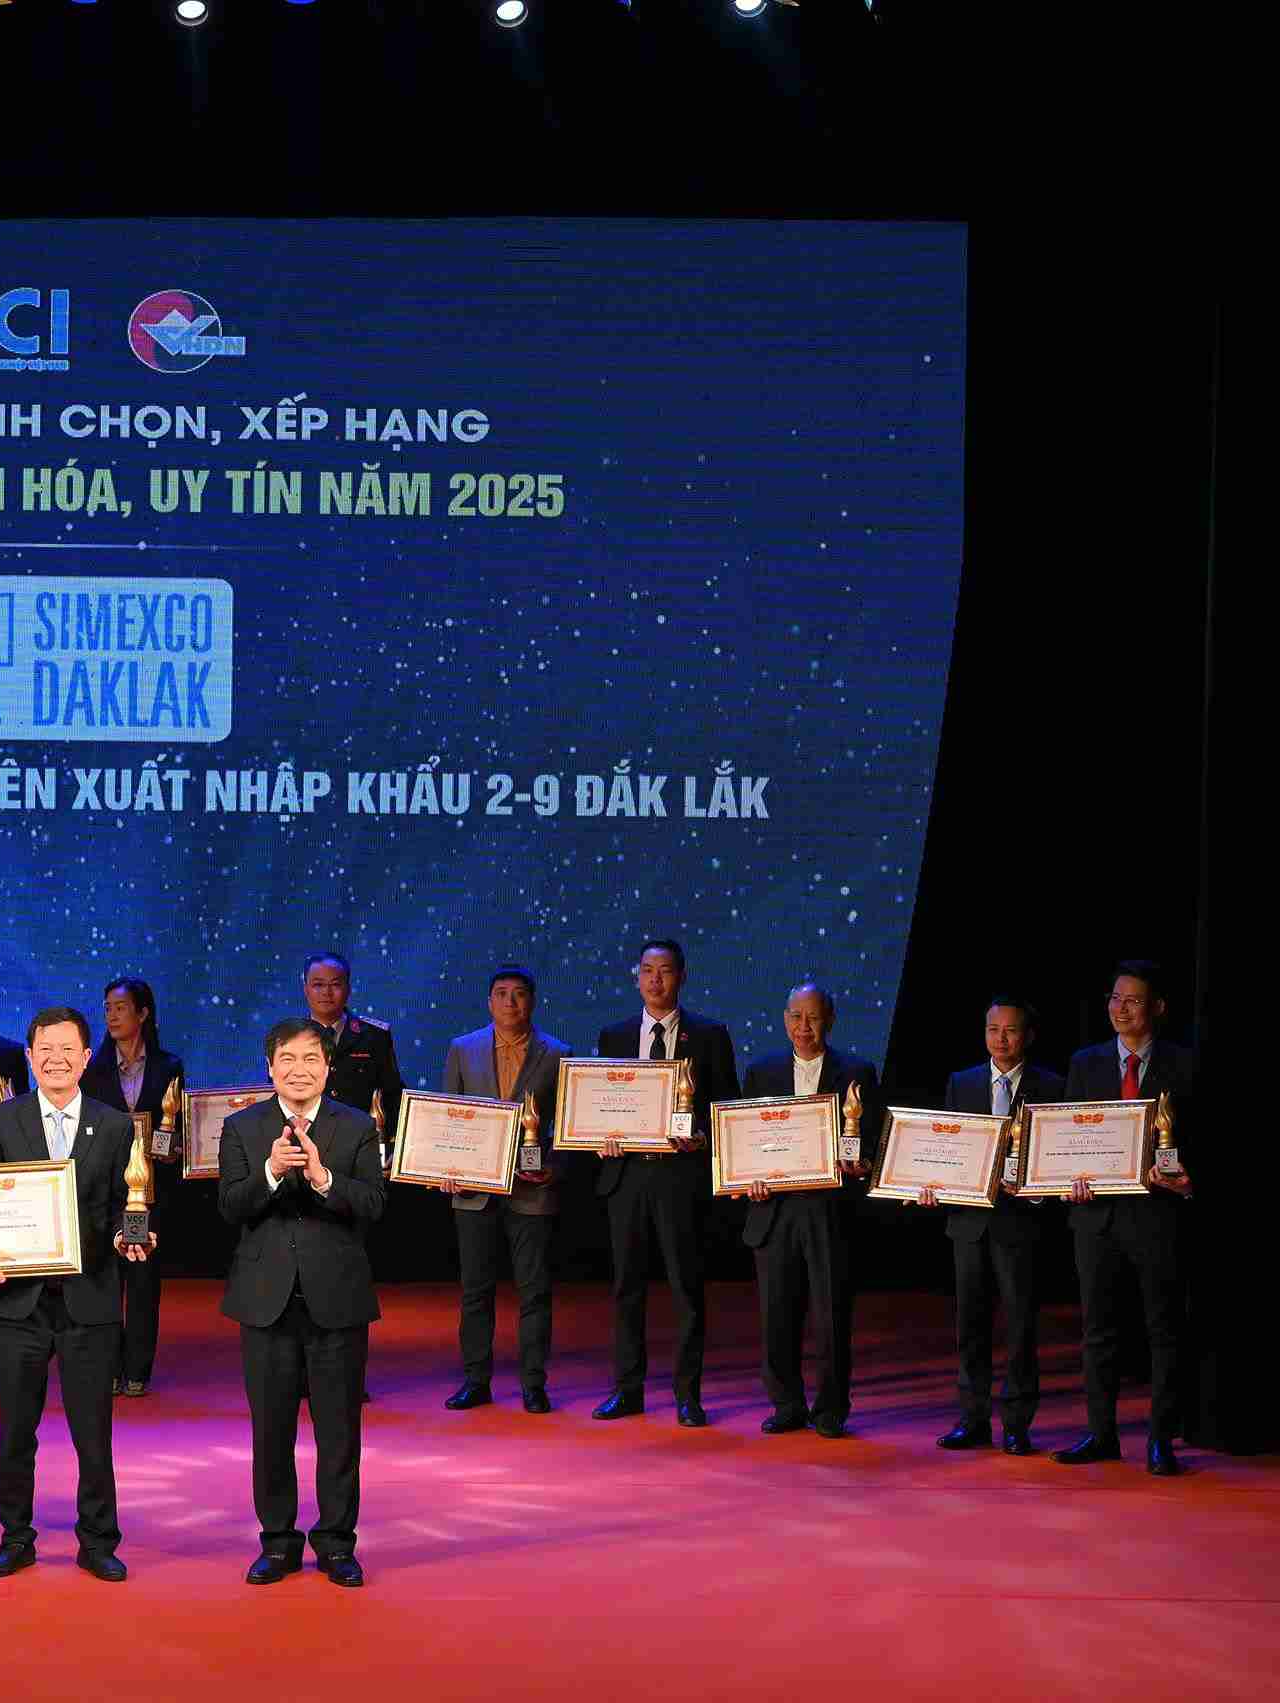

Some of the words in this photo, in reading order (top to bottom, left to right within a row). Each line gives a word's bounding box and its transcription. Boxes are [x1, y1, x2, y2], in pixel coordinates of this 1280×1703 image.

[60, 405, 220, 448] CHỌN,
[240, 393, 328, 440] XẾP
[346, 408, 489, 451] HẠNG
[23, 459, 131, 516] HÓA,
[151, 470, 209, 512] UY
[226, 461, 301, 513] TÍN
[320, 463, 430, 515] NĂM
[448, 474, 563, 516] 2025
[33, 591, 213, 653] SIMEXCO
[32, 659, 212, 728] DAKLAK
[72, 754, 190, 810] XUẤT
[206, 762, 330, 822] NHẬP
[348, 756, 471, 814] KHẨU
[486, 775, 559, 815] 2-9
[575, 760, 666, 816] ĐẮK
[685, 761, 768, 818] LẮK
